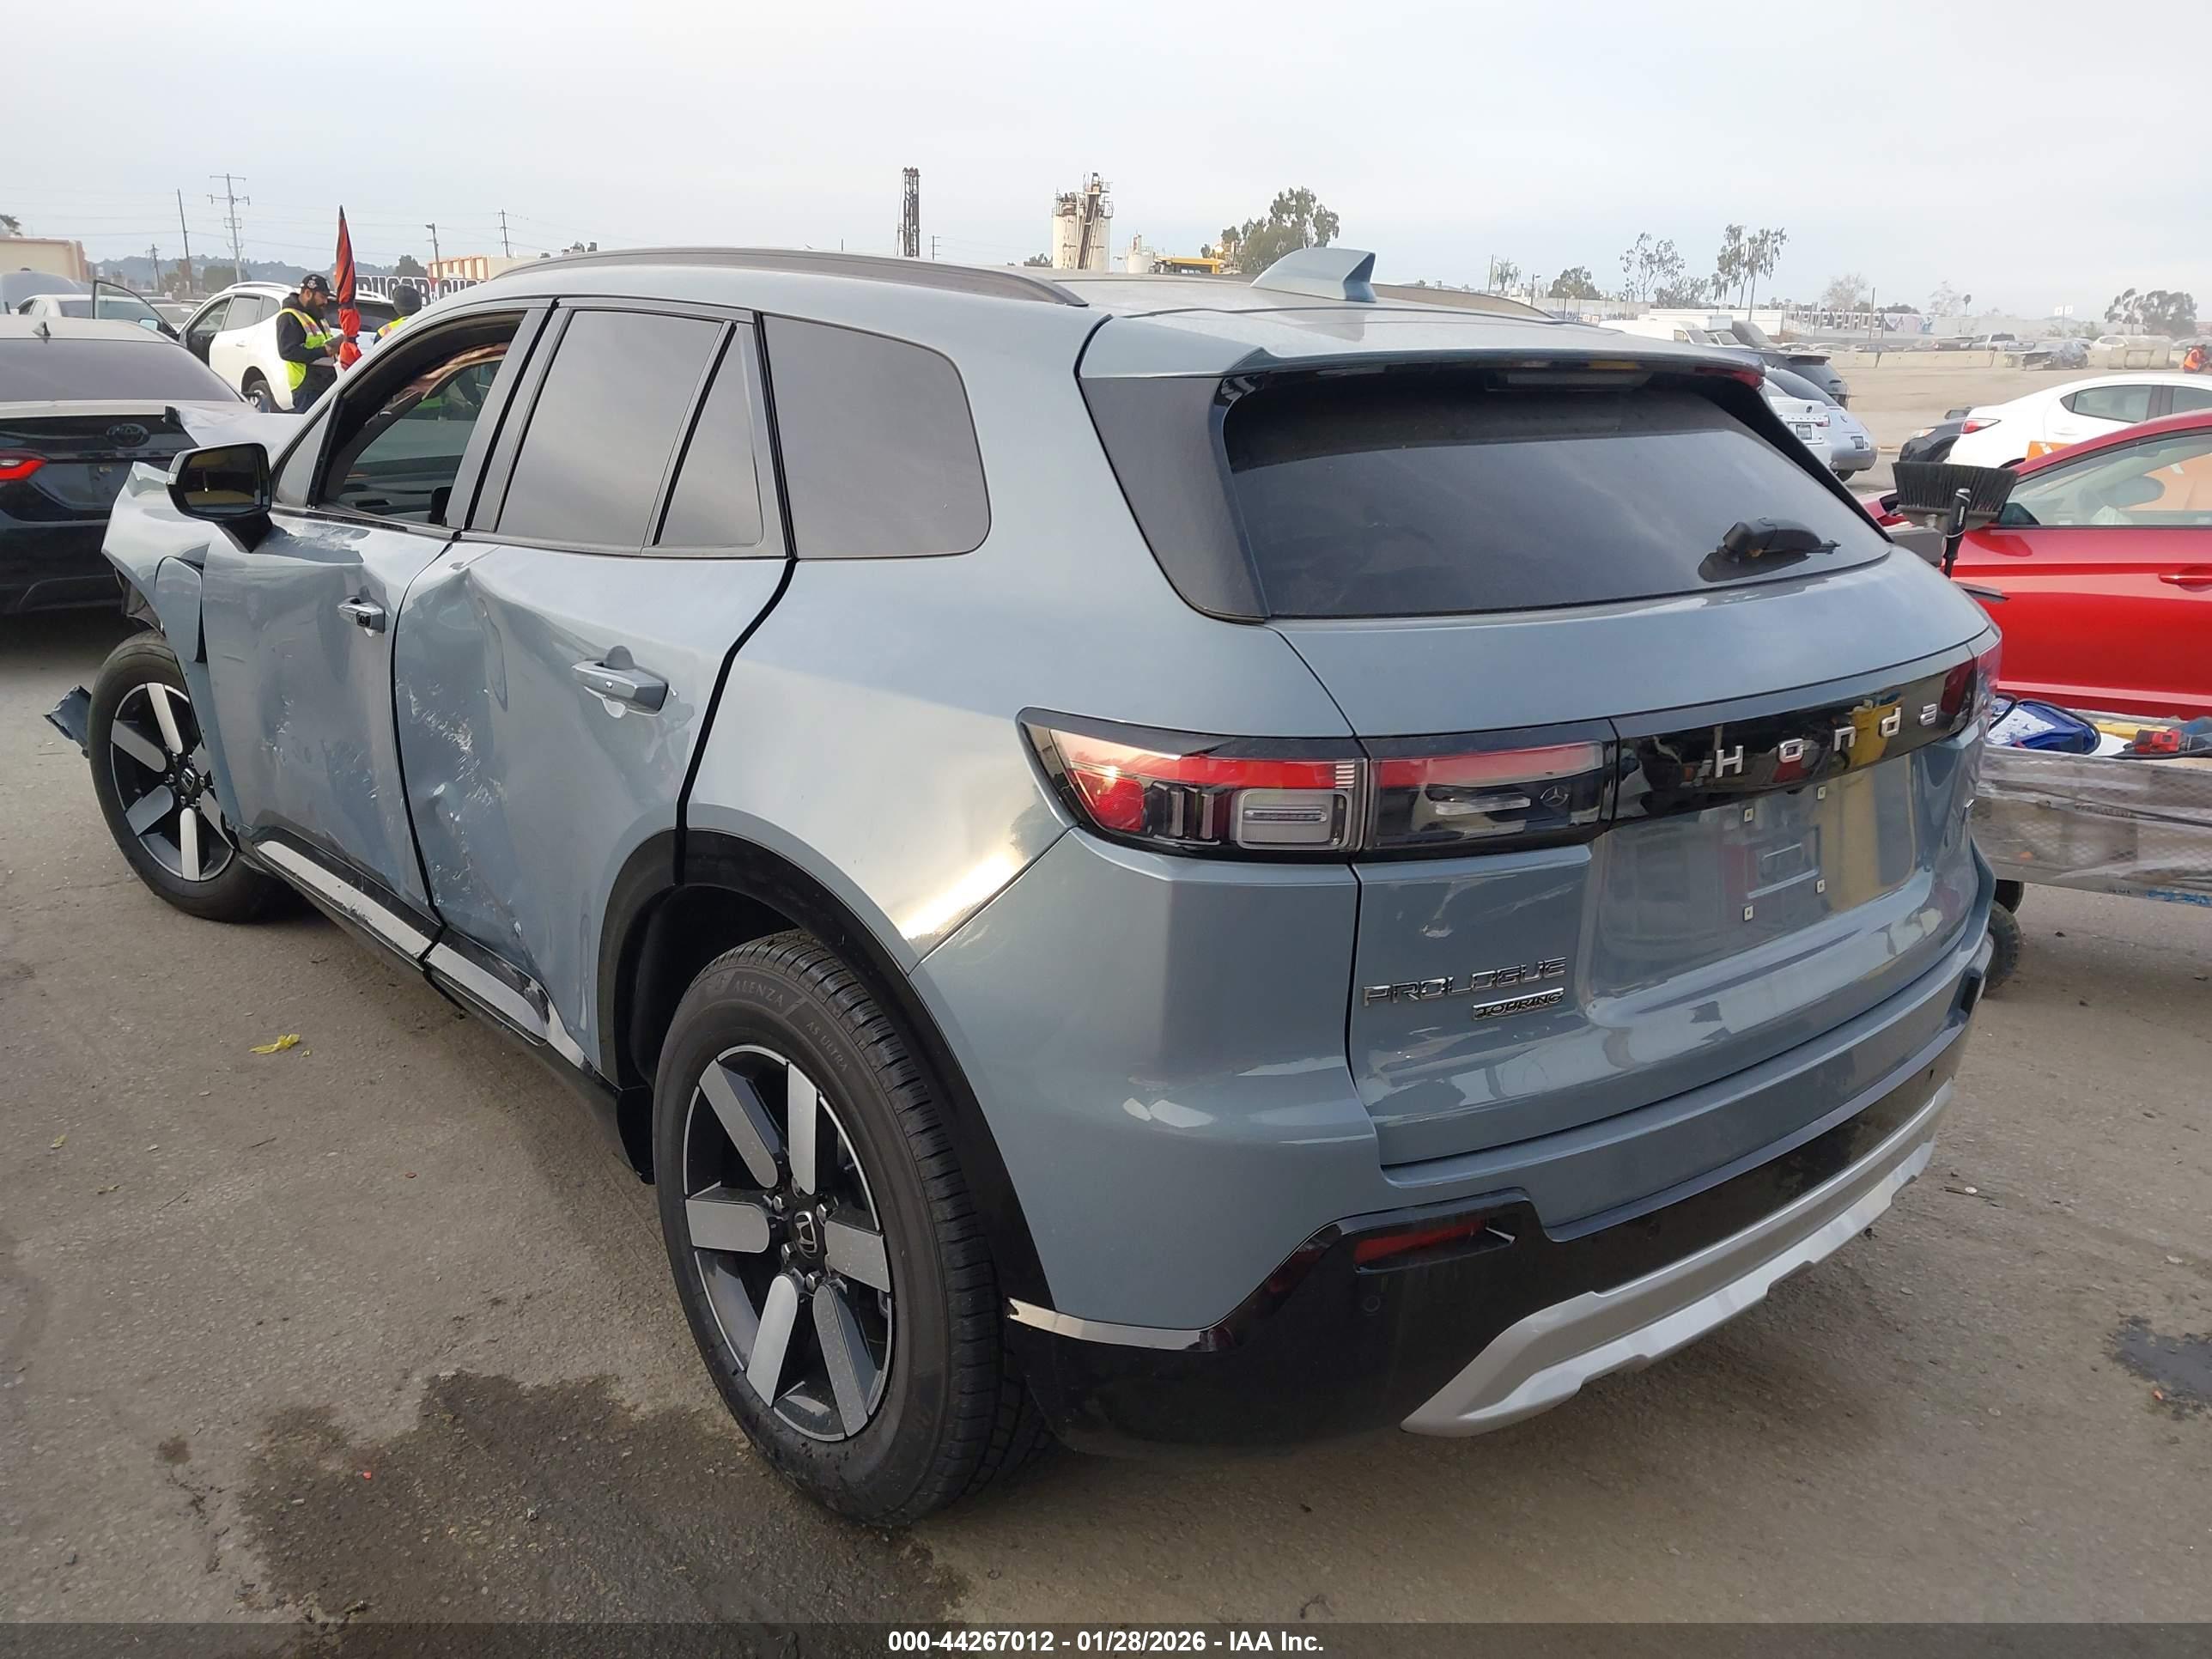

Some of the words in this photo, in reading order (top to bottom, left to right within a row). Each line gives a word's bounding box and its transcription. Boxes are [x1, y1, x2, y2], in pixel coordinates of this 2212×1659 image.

[1715, 702, 1937, 778] Honda
[733, 980, 785, 1008] ALENZA
[1363, 956, 1567, 1007] PROLOGUE
[1474, 989, 1565, 1019] TOURING
